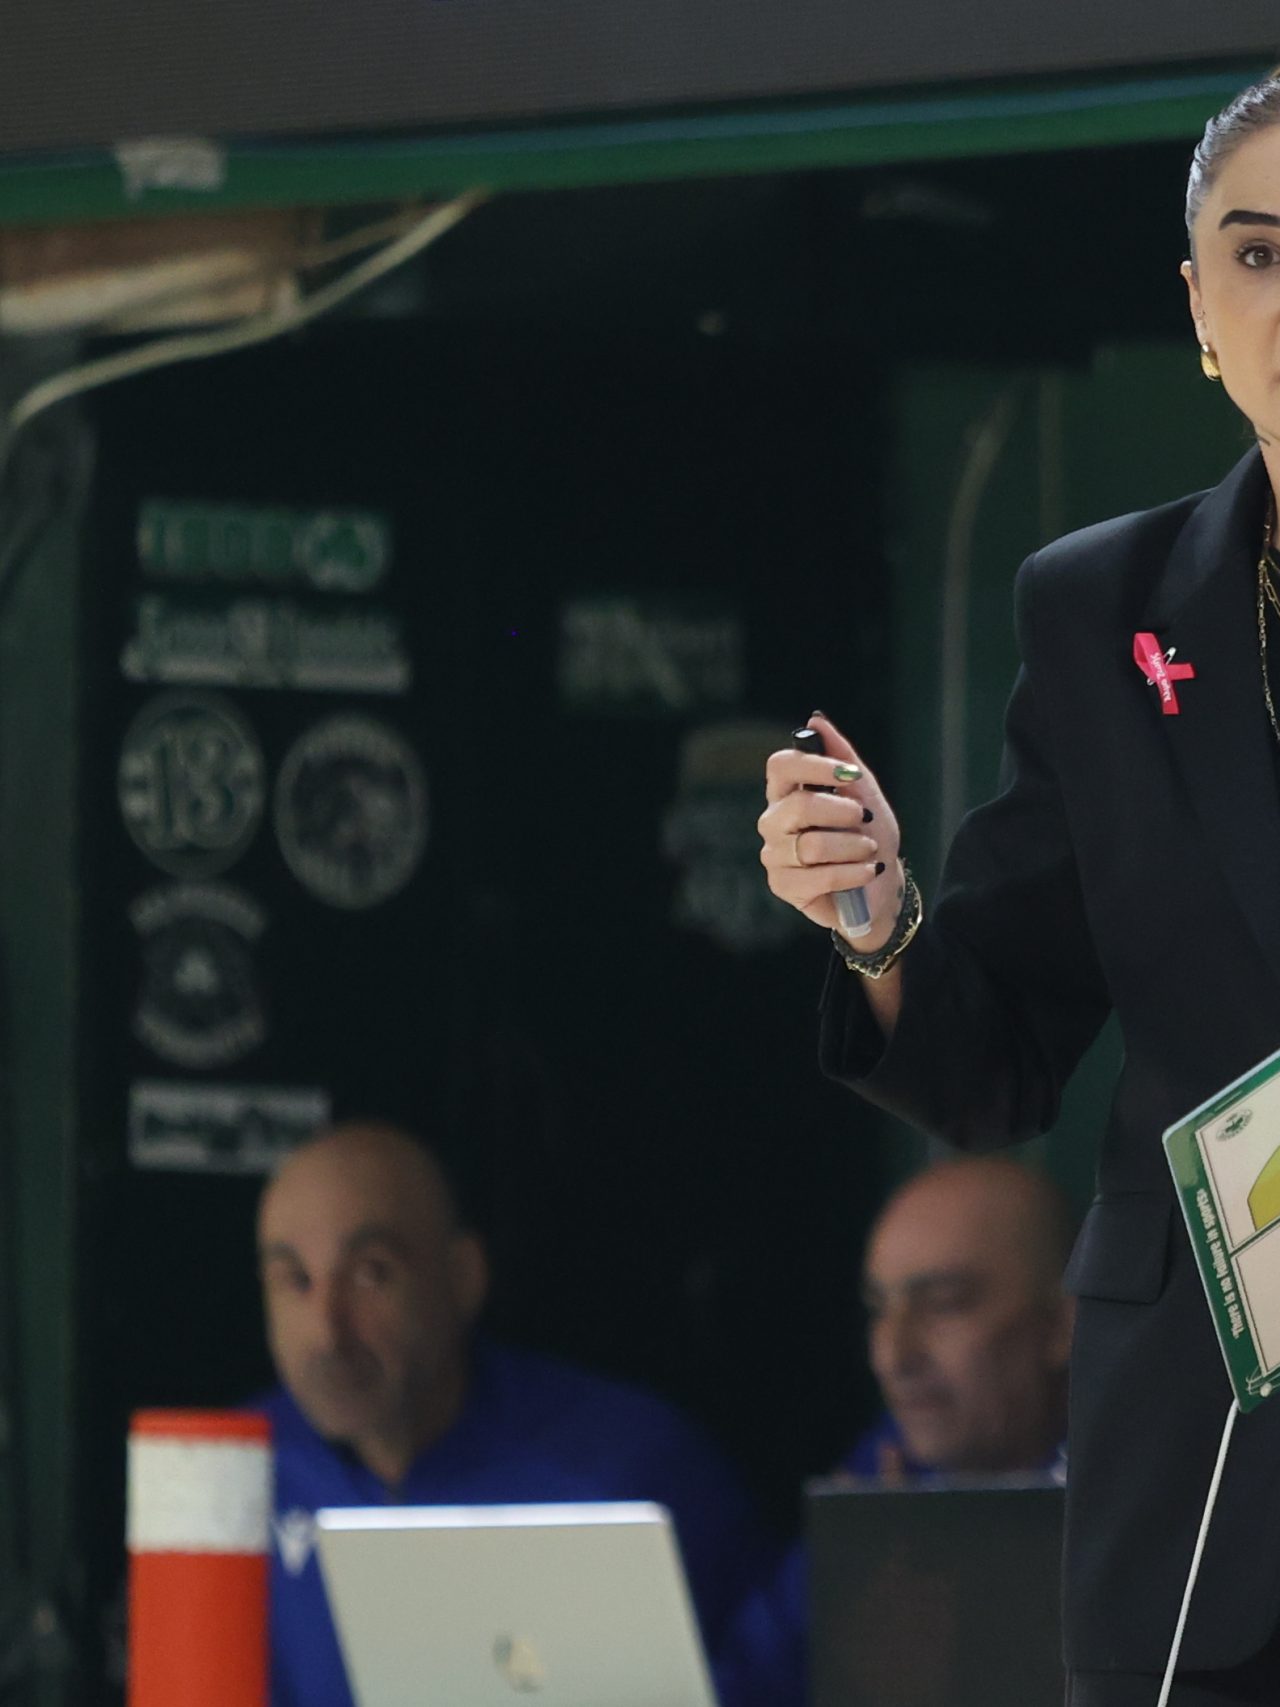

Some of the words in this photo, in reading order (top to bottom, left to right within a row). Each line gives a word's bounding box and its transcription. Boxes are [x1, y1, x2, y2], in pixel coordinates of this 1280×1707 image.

[1205, 1228, 1219, 1244] in
[1210, 1240, 1229, 1279] failure
[1220, 1275, 1233, 1294] no
[1223, 1290, 1236, 1307] is
